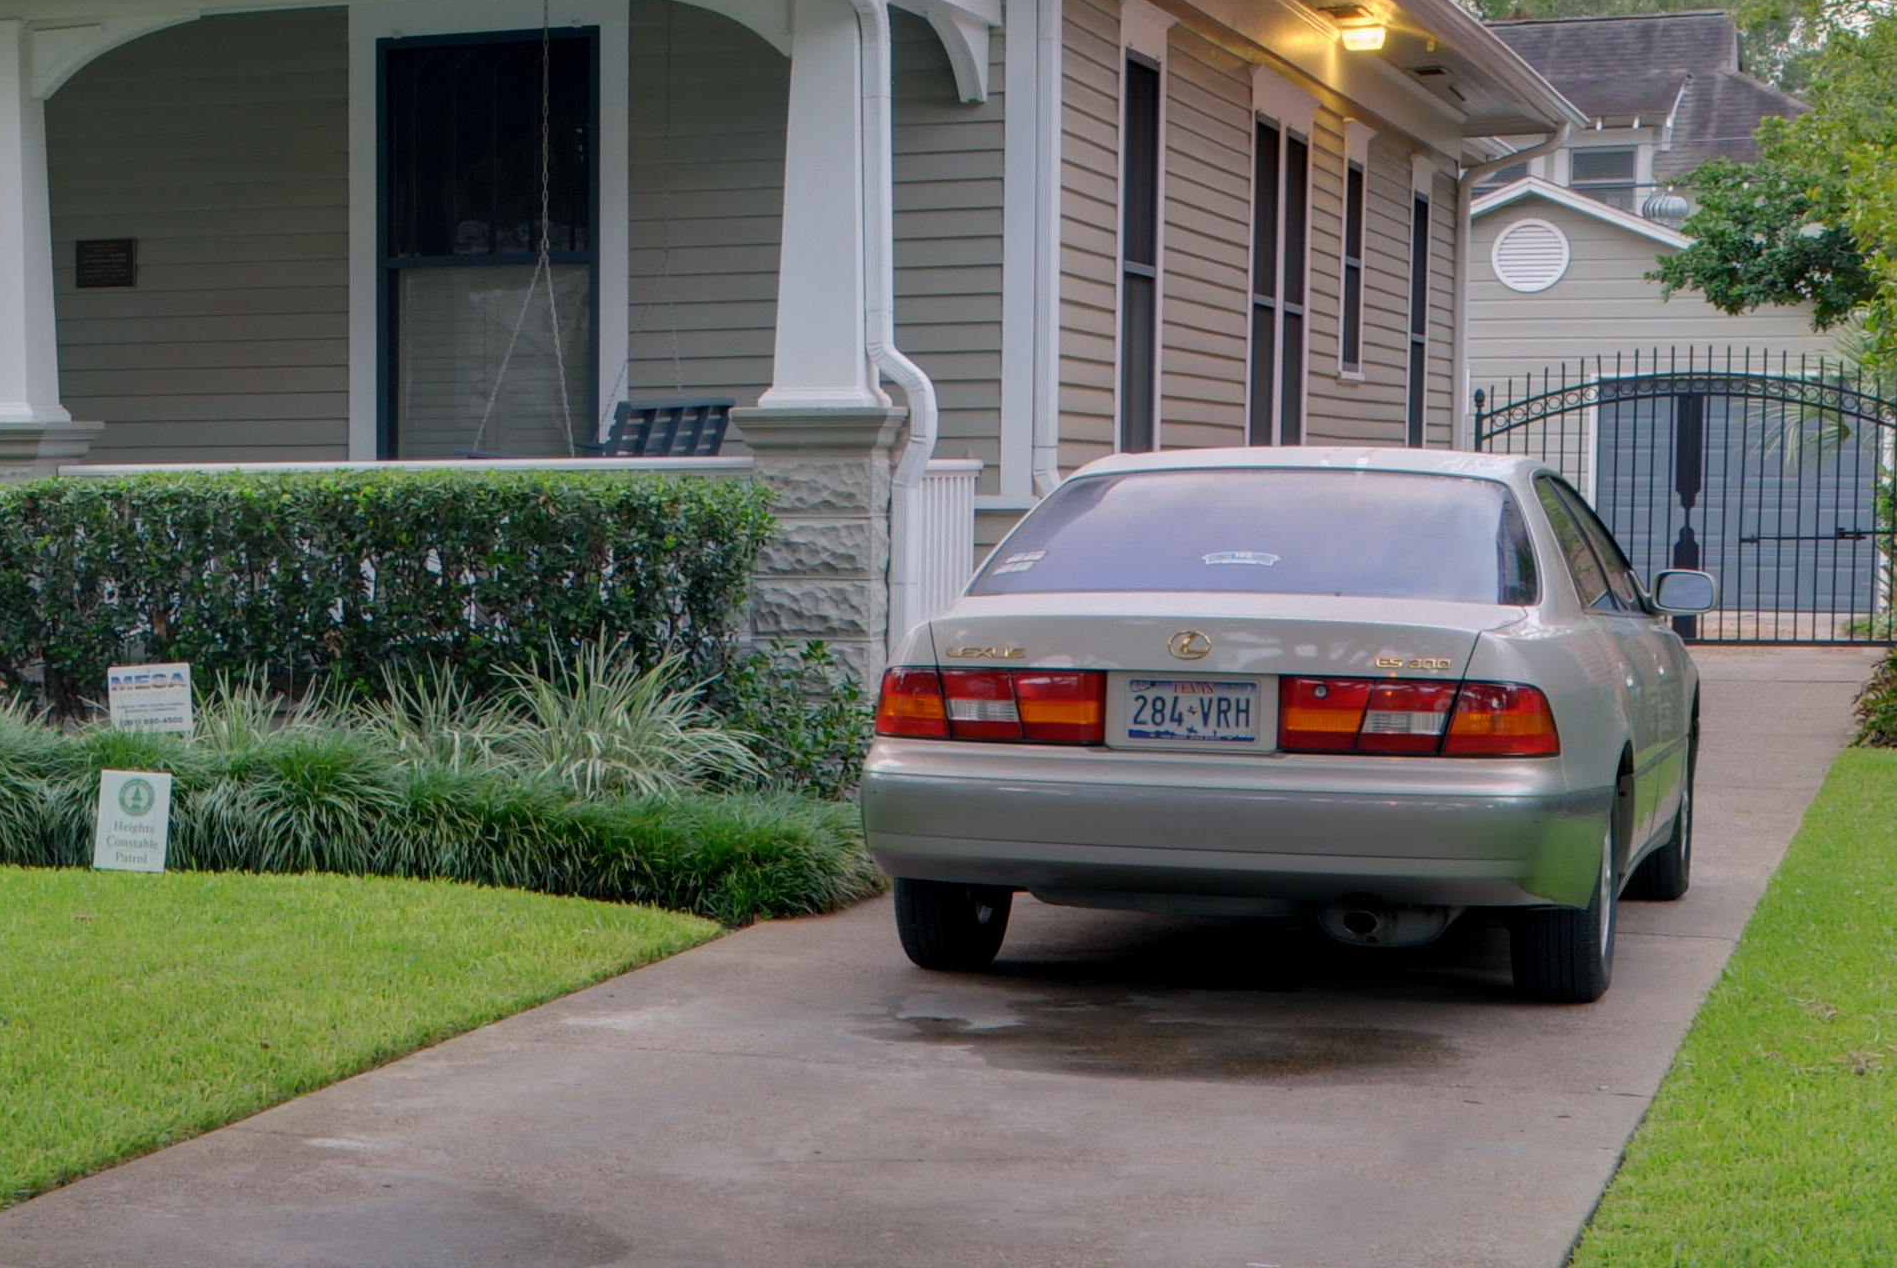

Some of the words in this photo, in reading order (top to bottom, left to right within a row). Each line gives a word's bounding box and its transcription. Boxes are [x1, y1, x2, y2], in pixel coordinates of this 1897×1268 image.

[945, 646, 1027, 659] LEXUS
[1374, 656, 1404, 670] ES
[1407, 657, 1454, 671] 300
[110, 672, 188, 692] MESA
[1172, 683, 1215, 695] TEXAS
[1132, 694, 1185, 728] 284
[1198, 695, 1252, 729] VRH
[113, 820, 156, 835] Heights
[105, 835, 159, 850] Constable
[114, 851, 148, 865] Patrol
